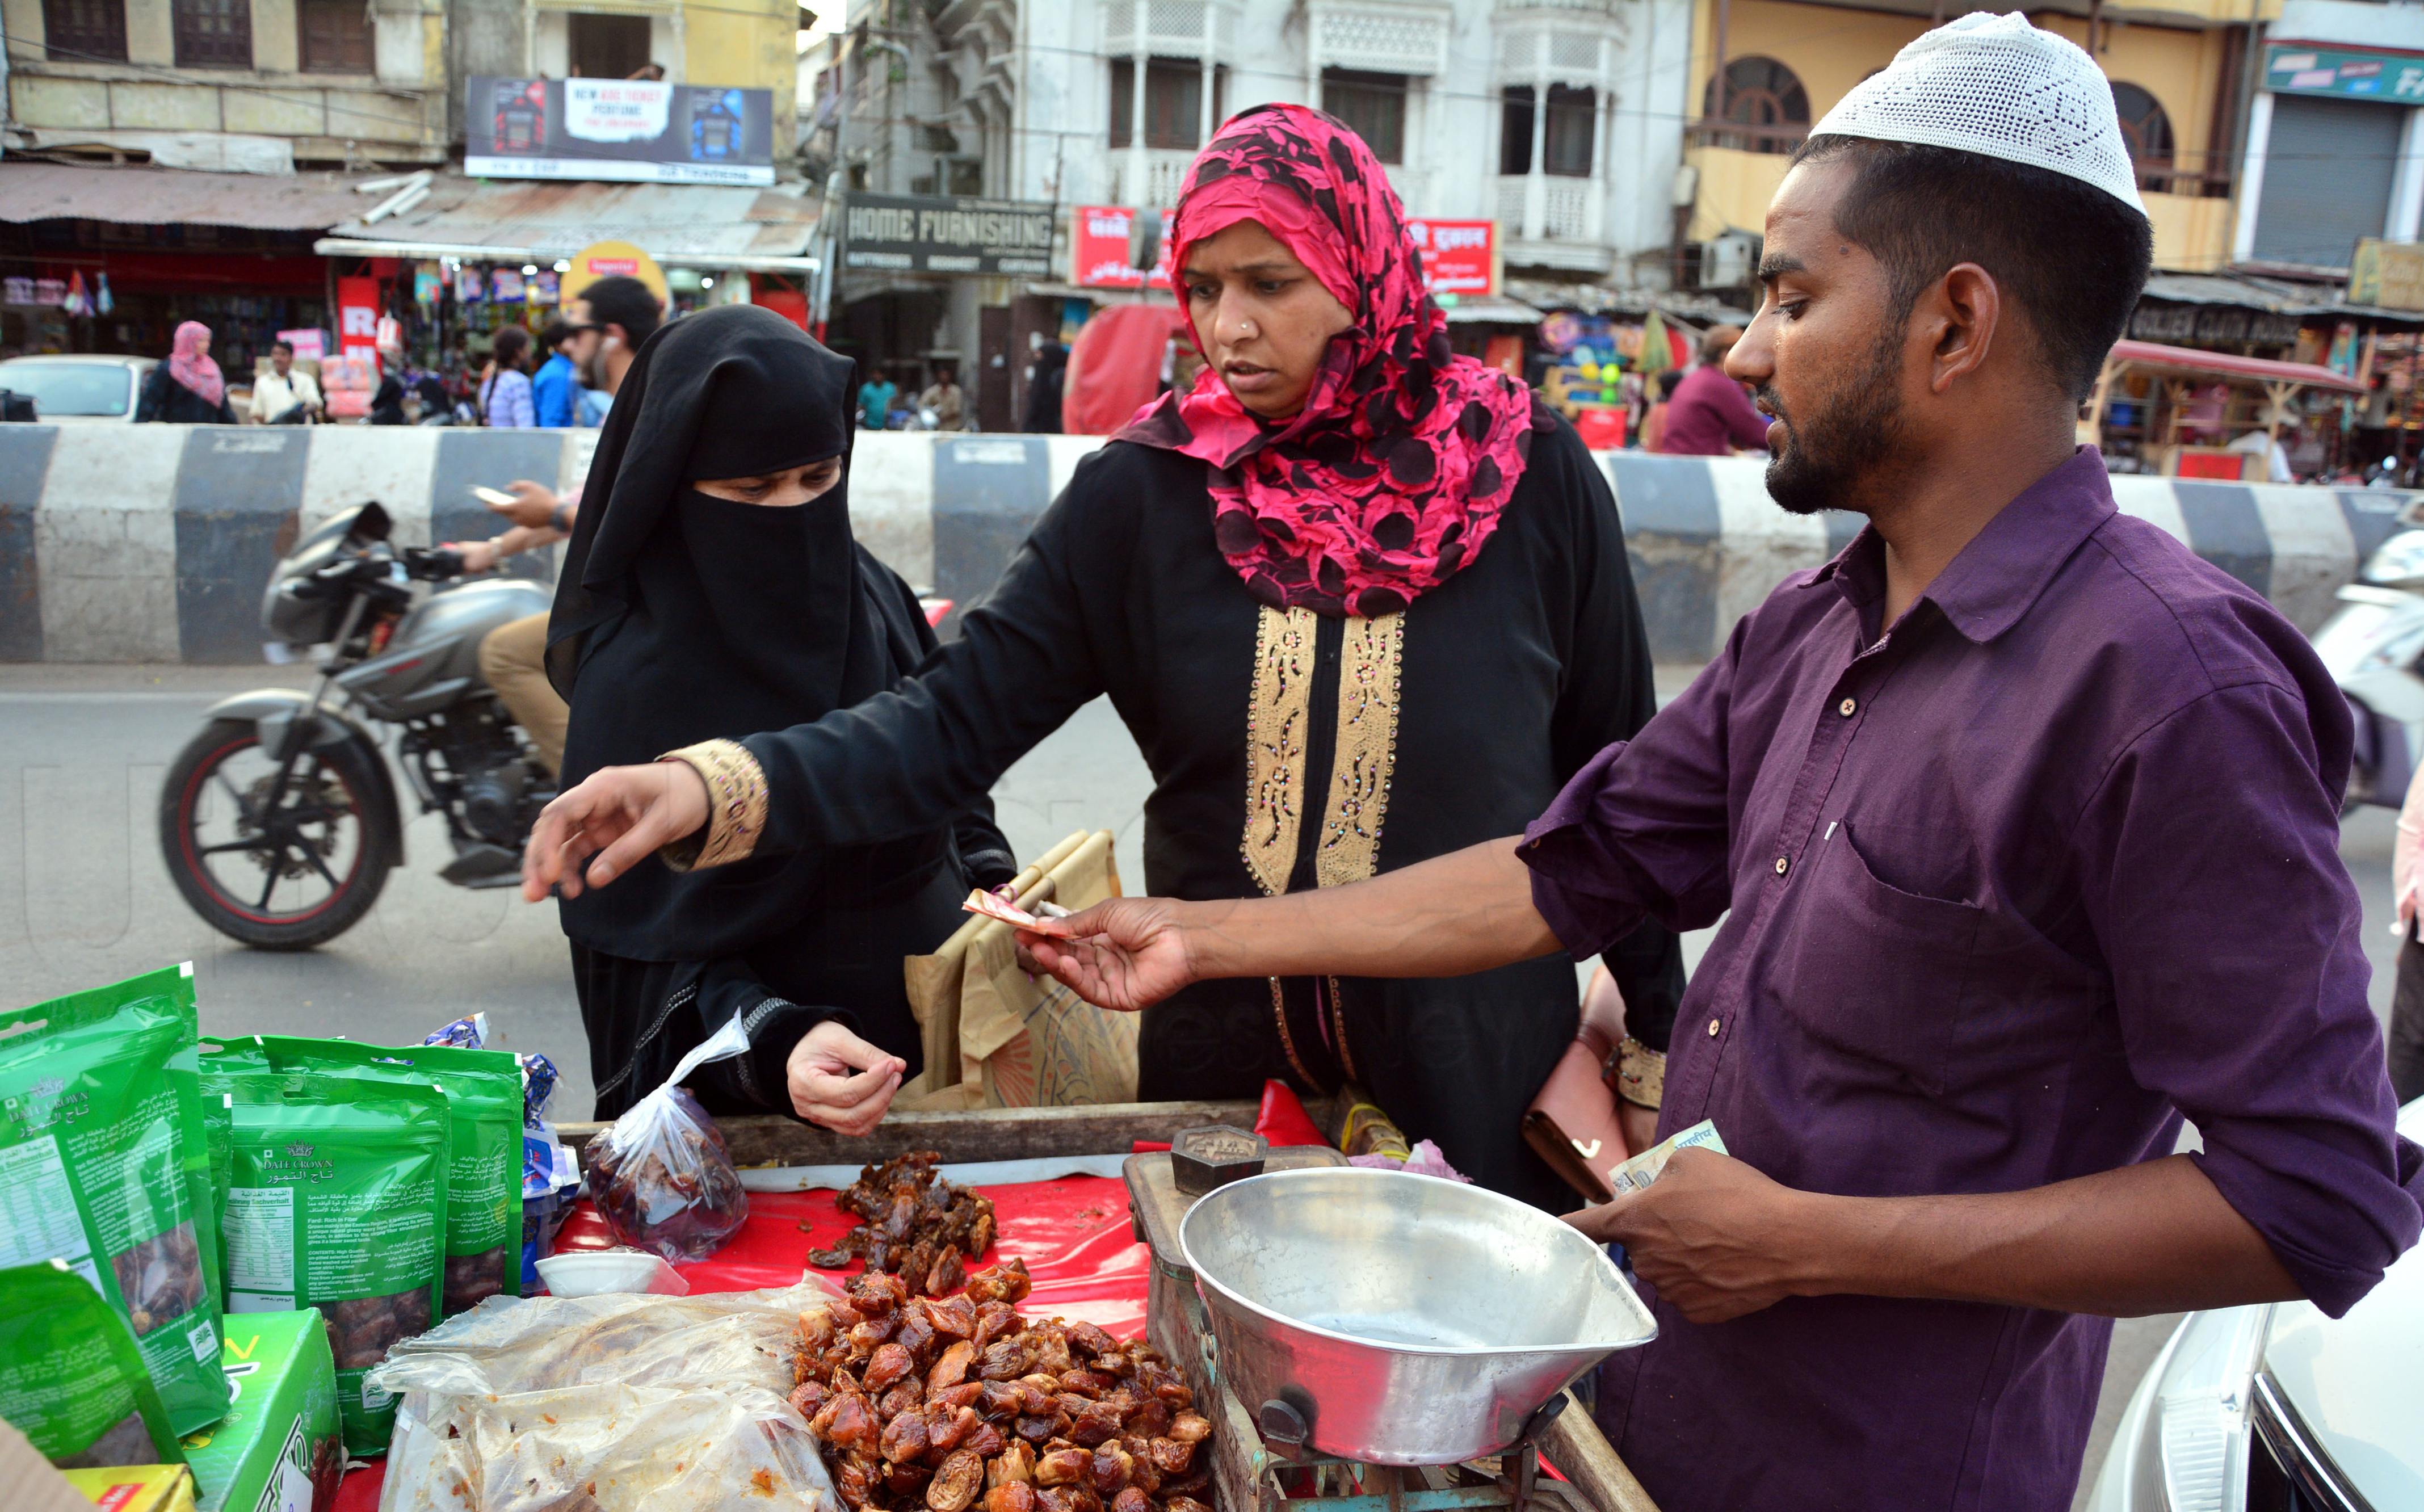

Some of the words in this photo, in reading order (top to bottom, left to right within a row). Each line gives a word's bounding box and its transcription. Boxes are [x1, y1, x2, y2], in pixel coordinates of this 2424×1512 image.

[848, 207, 915, 244] HOME
[919, 211, 1052, 248] FURNISHING
[1432, 227, 1487, 251] दुकान
[9, 1105, 44, 1124] DATE
[46, 1091, 89, 1110] CROWN
[66, 1104, 89, 1124] تاج
[19, 1112, 61, 1138] التمور
[264, 1160, 291, 1170] DATE
[293, 1160, 334, 1169] CROWN
[267, 1171, 306, 1184] التمور
[311, 1171, 333, 1183] تاج
